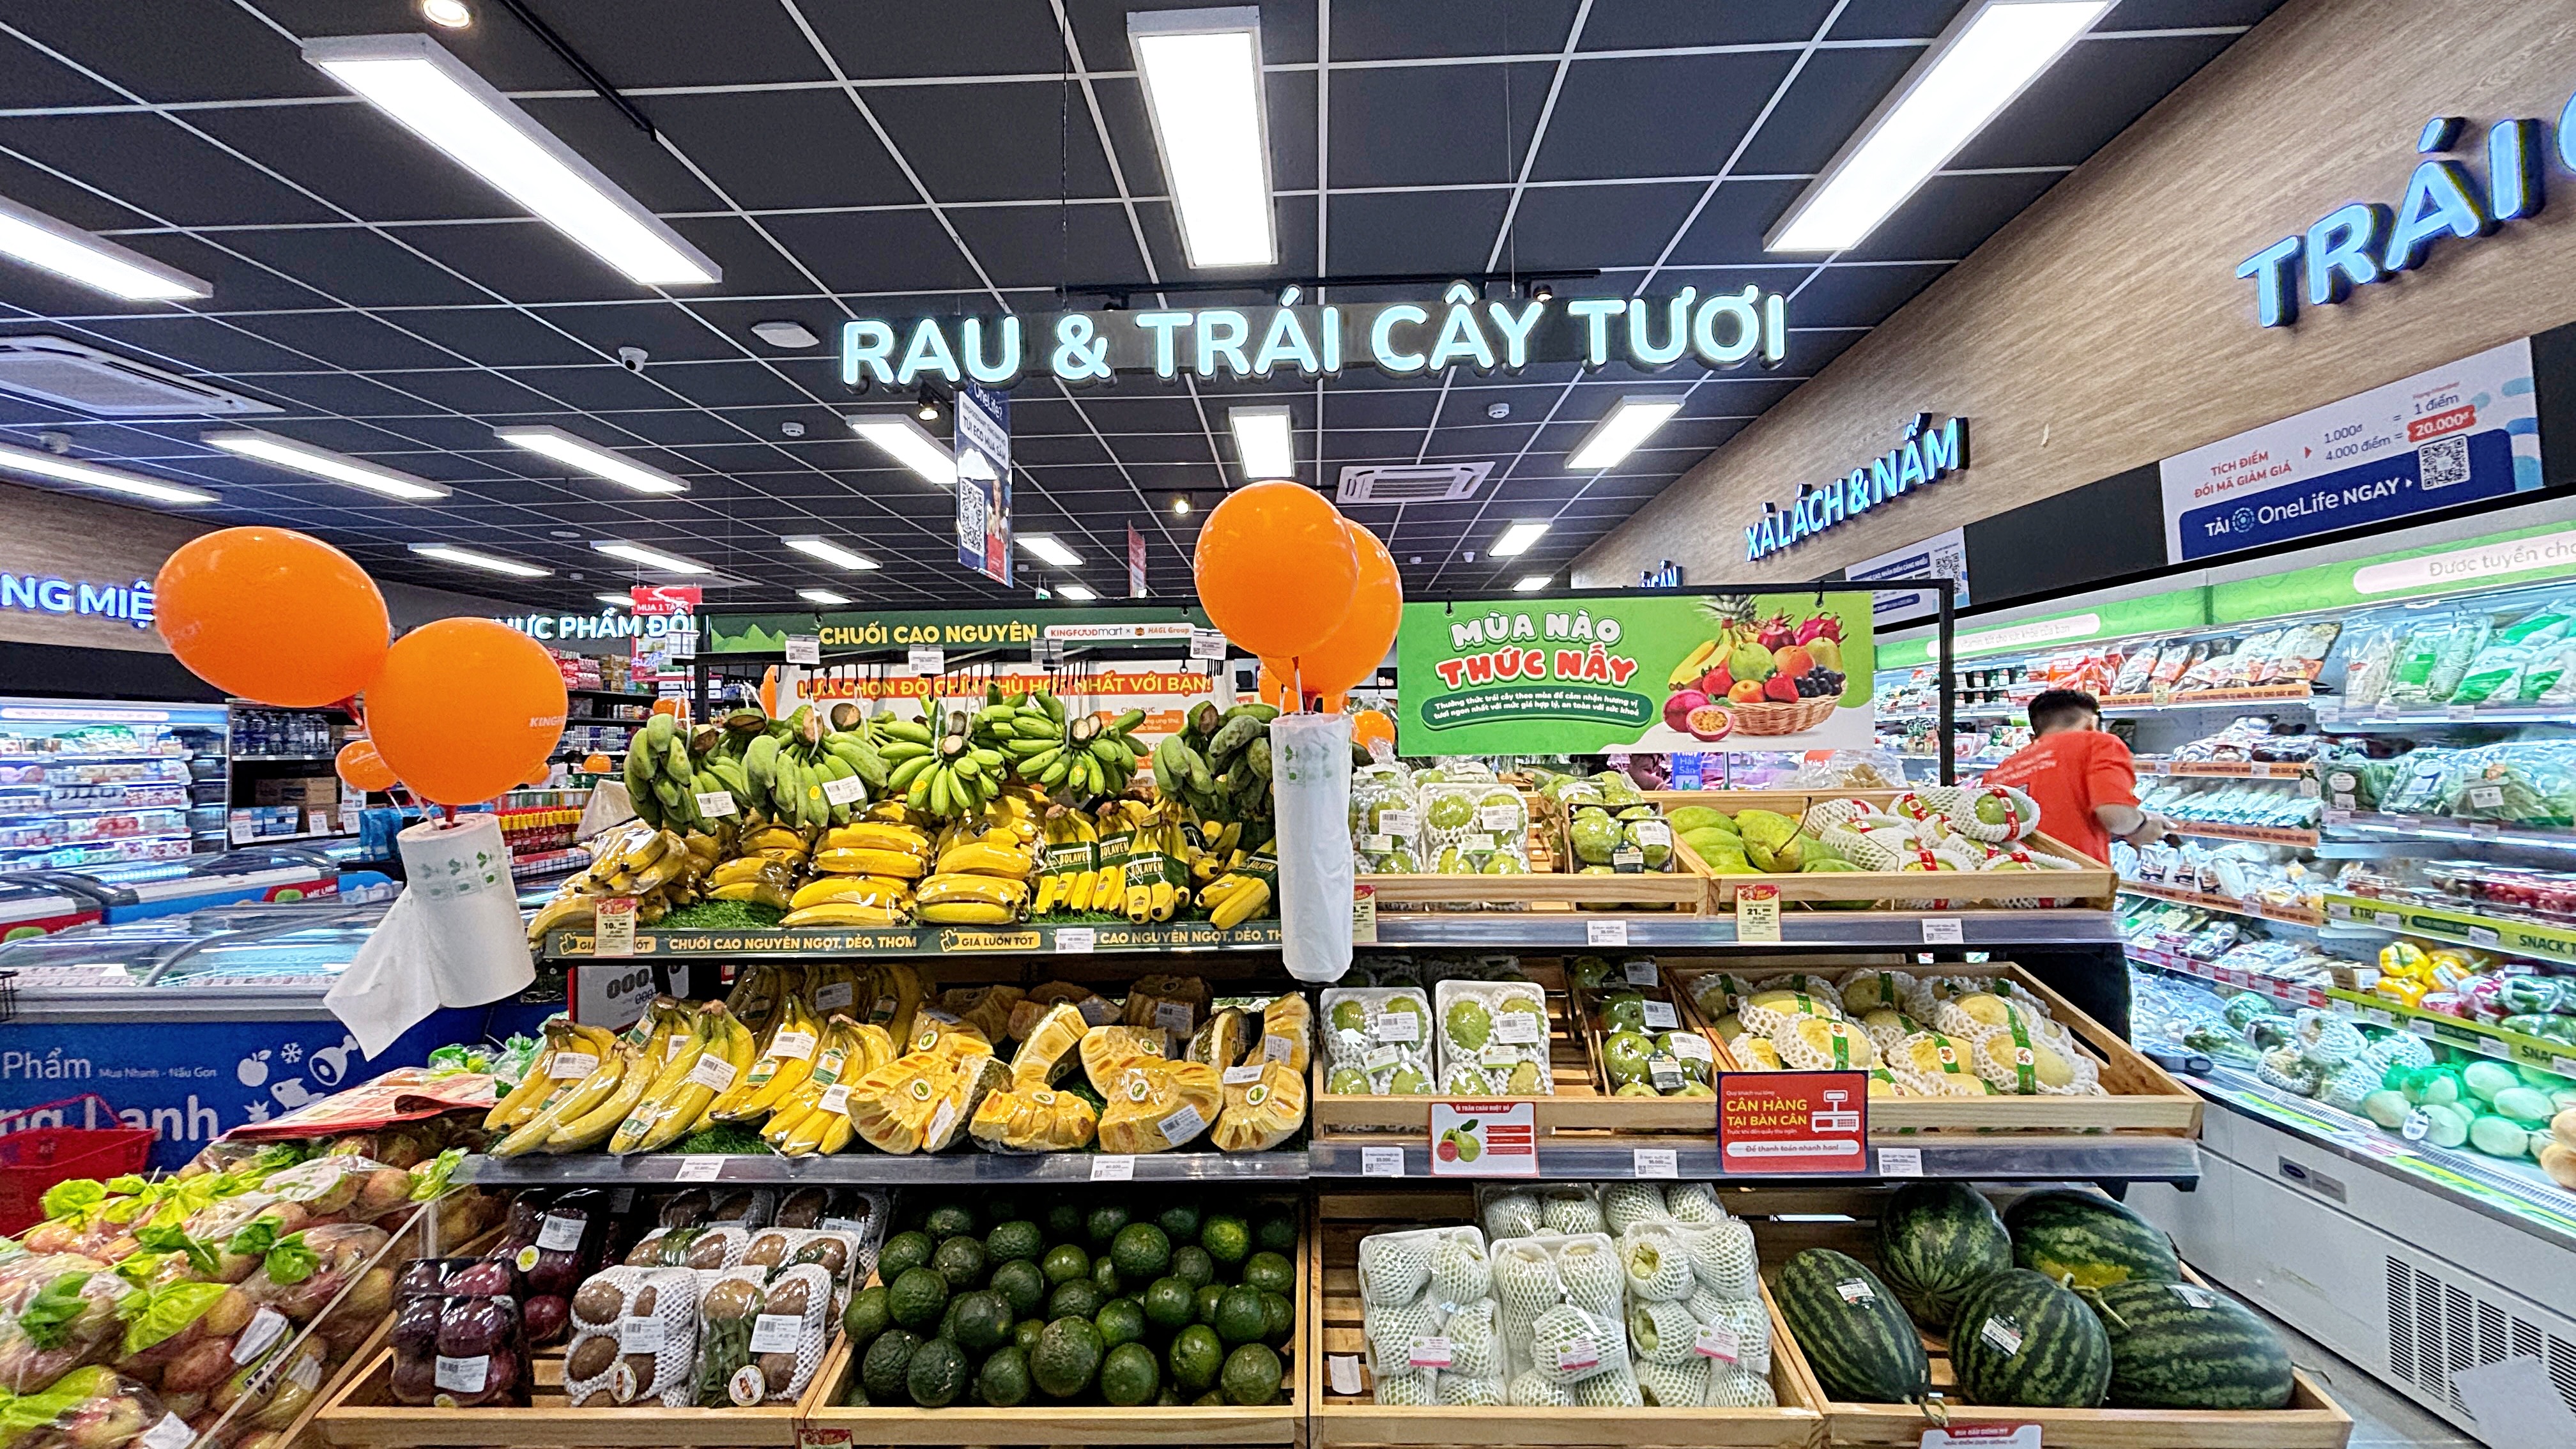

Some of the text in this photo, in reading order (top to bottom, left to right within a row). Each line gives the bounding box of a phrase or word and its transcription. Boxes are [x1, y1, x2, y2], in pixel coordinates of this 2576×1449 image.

[2235, 117, 2524, 328] TRÁI
[841, 282, 1786, 385] RAU & TRÁI CÂY TƯƠI
[2211, 450, 2269, 477] TÍCH ĐIỂM
[2217, 477, 2234, 492] MÃ
[2237, 470, 2267, 486] GIẢM
[2270, 459, 2292, 477] GIÁ
[1745, 413, 1959, 562] XÀ LÁCH & NẤM
[2205, 477, 2400, 537] TẢI OneLife NGAY
[2429, 560, 2476, 577] Được
[80, 578, 156, 629] MIỆ
[559, 606, 640, 638] PHẨM
[819, 620, 1038, 644] CHUỐI CAO NGUYÊN
[1450, 608, 1622, 648] MÙA NÀO
[1438, 646, 1545, 687] THỨC
[1127, 671, 1162, 693] VỚI
[635, 939, 650, 950] ỐT
[670, 935, 710, 951] CHUỐI
[714, 938, 742, 949] CAO
[744, 936, 800, 950] NGUYÊN
[803, 937, 842, 951] NGỌT,
[877, 936, 917, 949] THƠM
[962, 933, 1034, 947] GIÁ LUÔN TỐT
[1100, 932, 1129, 944] CAO
[1131, 928, 1188, 944] NGUYÊN
[1192, 931, 1230, 946] NGỌT,
[1267, 930, 1282, 941] TH
[2519, 935, 2565, 953] SNACK
[3, 1046, 91, 1079] Phẩm
[1726, 1096, 1807, 1112] CÂN HÀNG
[1726, 1112, 1807, 1128] TẠI BÀN CÂN
